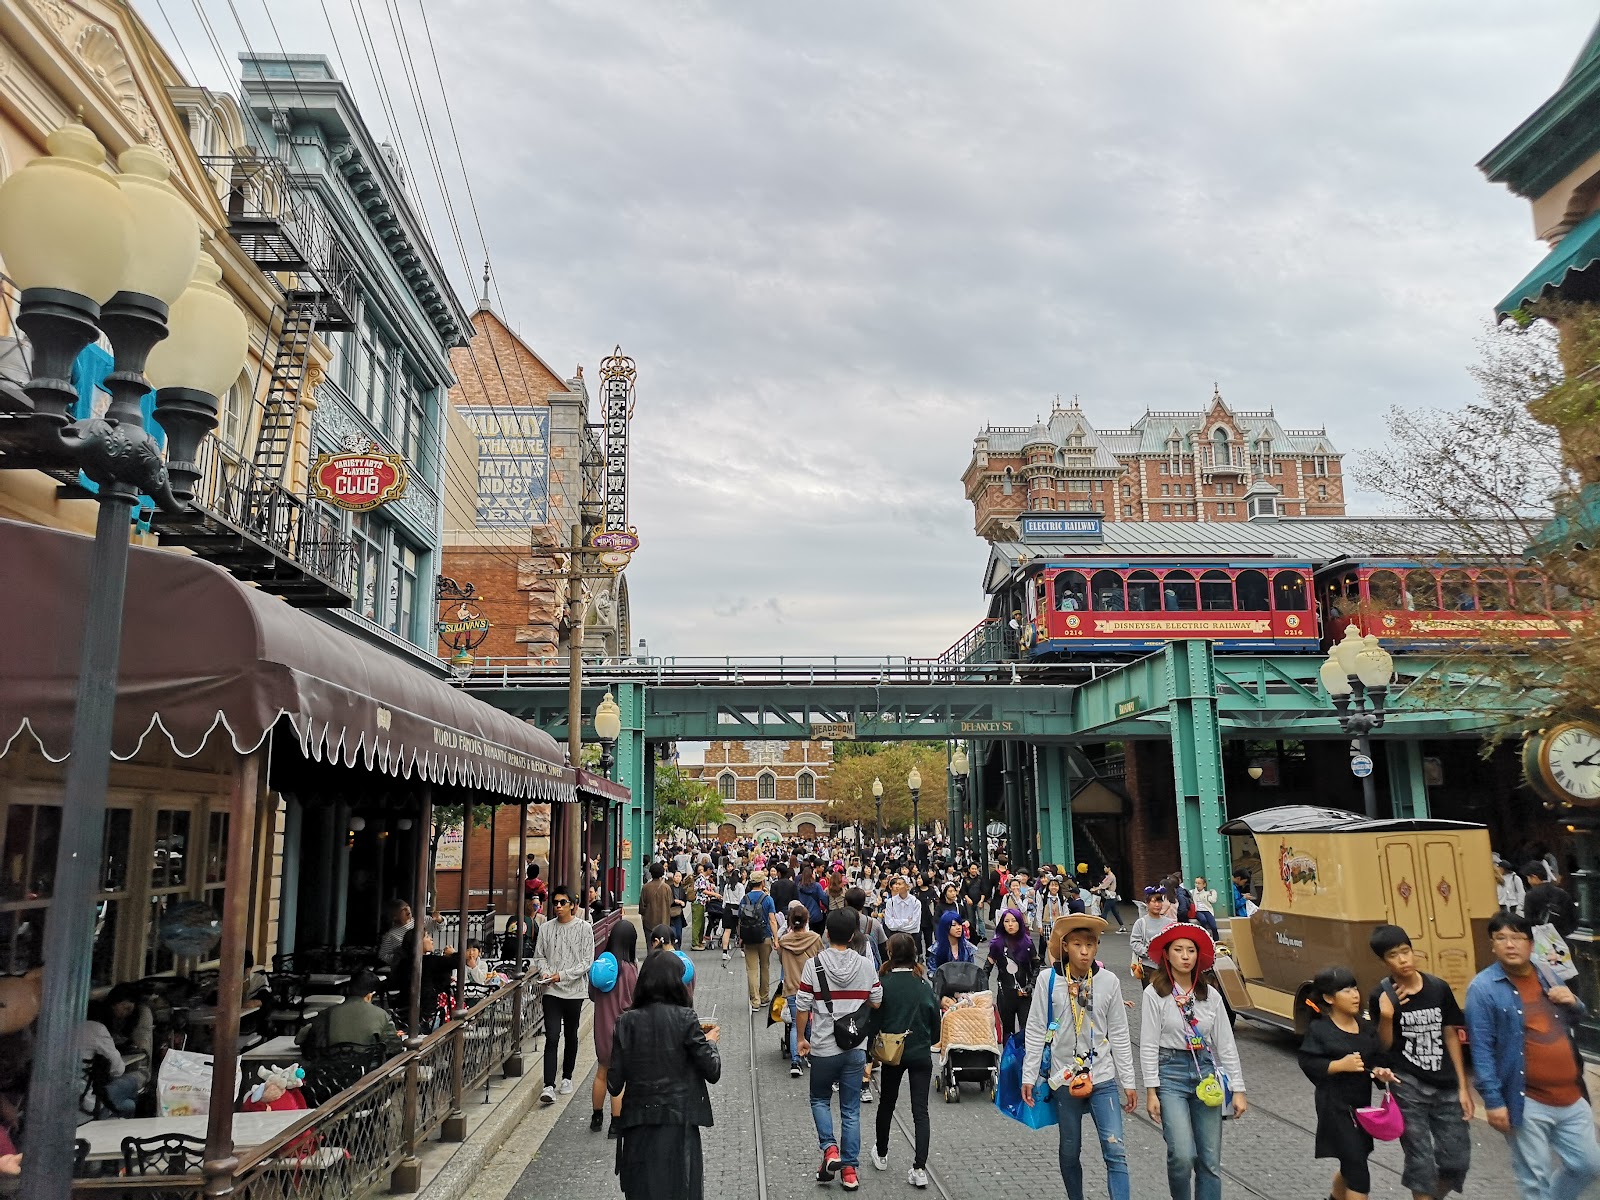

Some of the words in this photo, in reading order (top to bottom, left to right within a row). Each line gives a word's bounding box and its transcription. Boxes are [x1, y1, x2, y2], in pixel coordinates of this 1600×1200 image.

[479, 439, 545, 454] THEATRE
[607, 381, 626, 530] BROADWAY
[333, 459, 365, 469] VARIETY
[365, 459, 384, 470] ARTS
[342, 468, 374, 476] PLAYERS
[335, 476, 379, 495] CLUB
[477, 478, 532, 494] NDEST
[1029, 521, 1062, 531] ELECTRIC
[1064, 521, 1096, 531] RAILWAY
[1113, 622, 1162, 630] DISNEYSEA
[1165, 622, 1209, 630] ELECTRIC
[1212, 622, 1252, 630] RAILWAY
[813, 724, 853, 736] HEADROOM
[961, 721, 1001, 732] DELANCEY
[1002, 721, 1014, 731] ST.
[433, 727, 458, 749] WORLD
[459, 735, 483, 756] FAMOUS
[483, 743, 508, 764] ROMANTIC
[1191, 1036, 1202, 1045] OY
